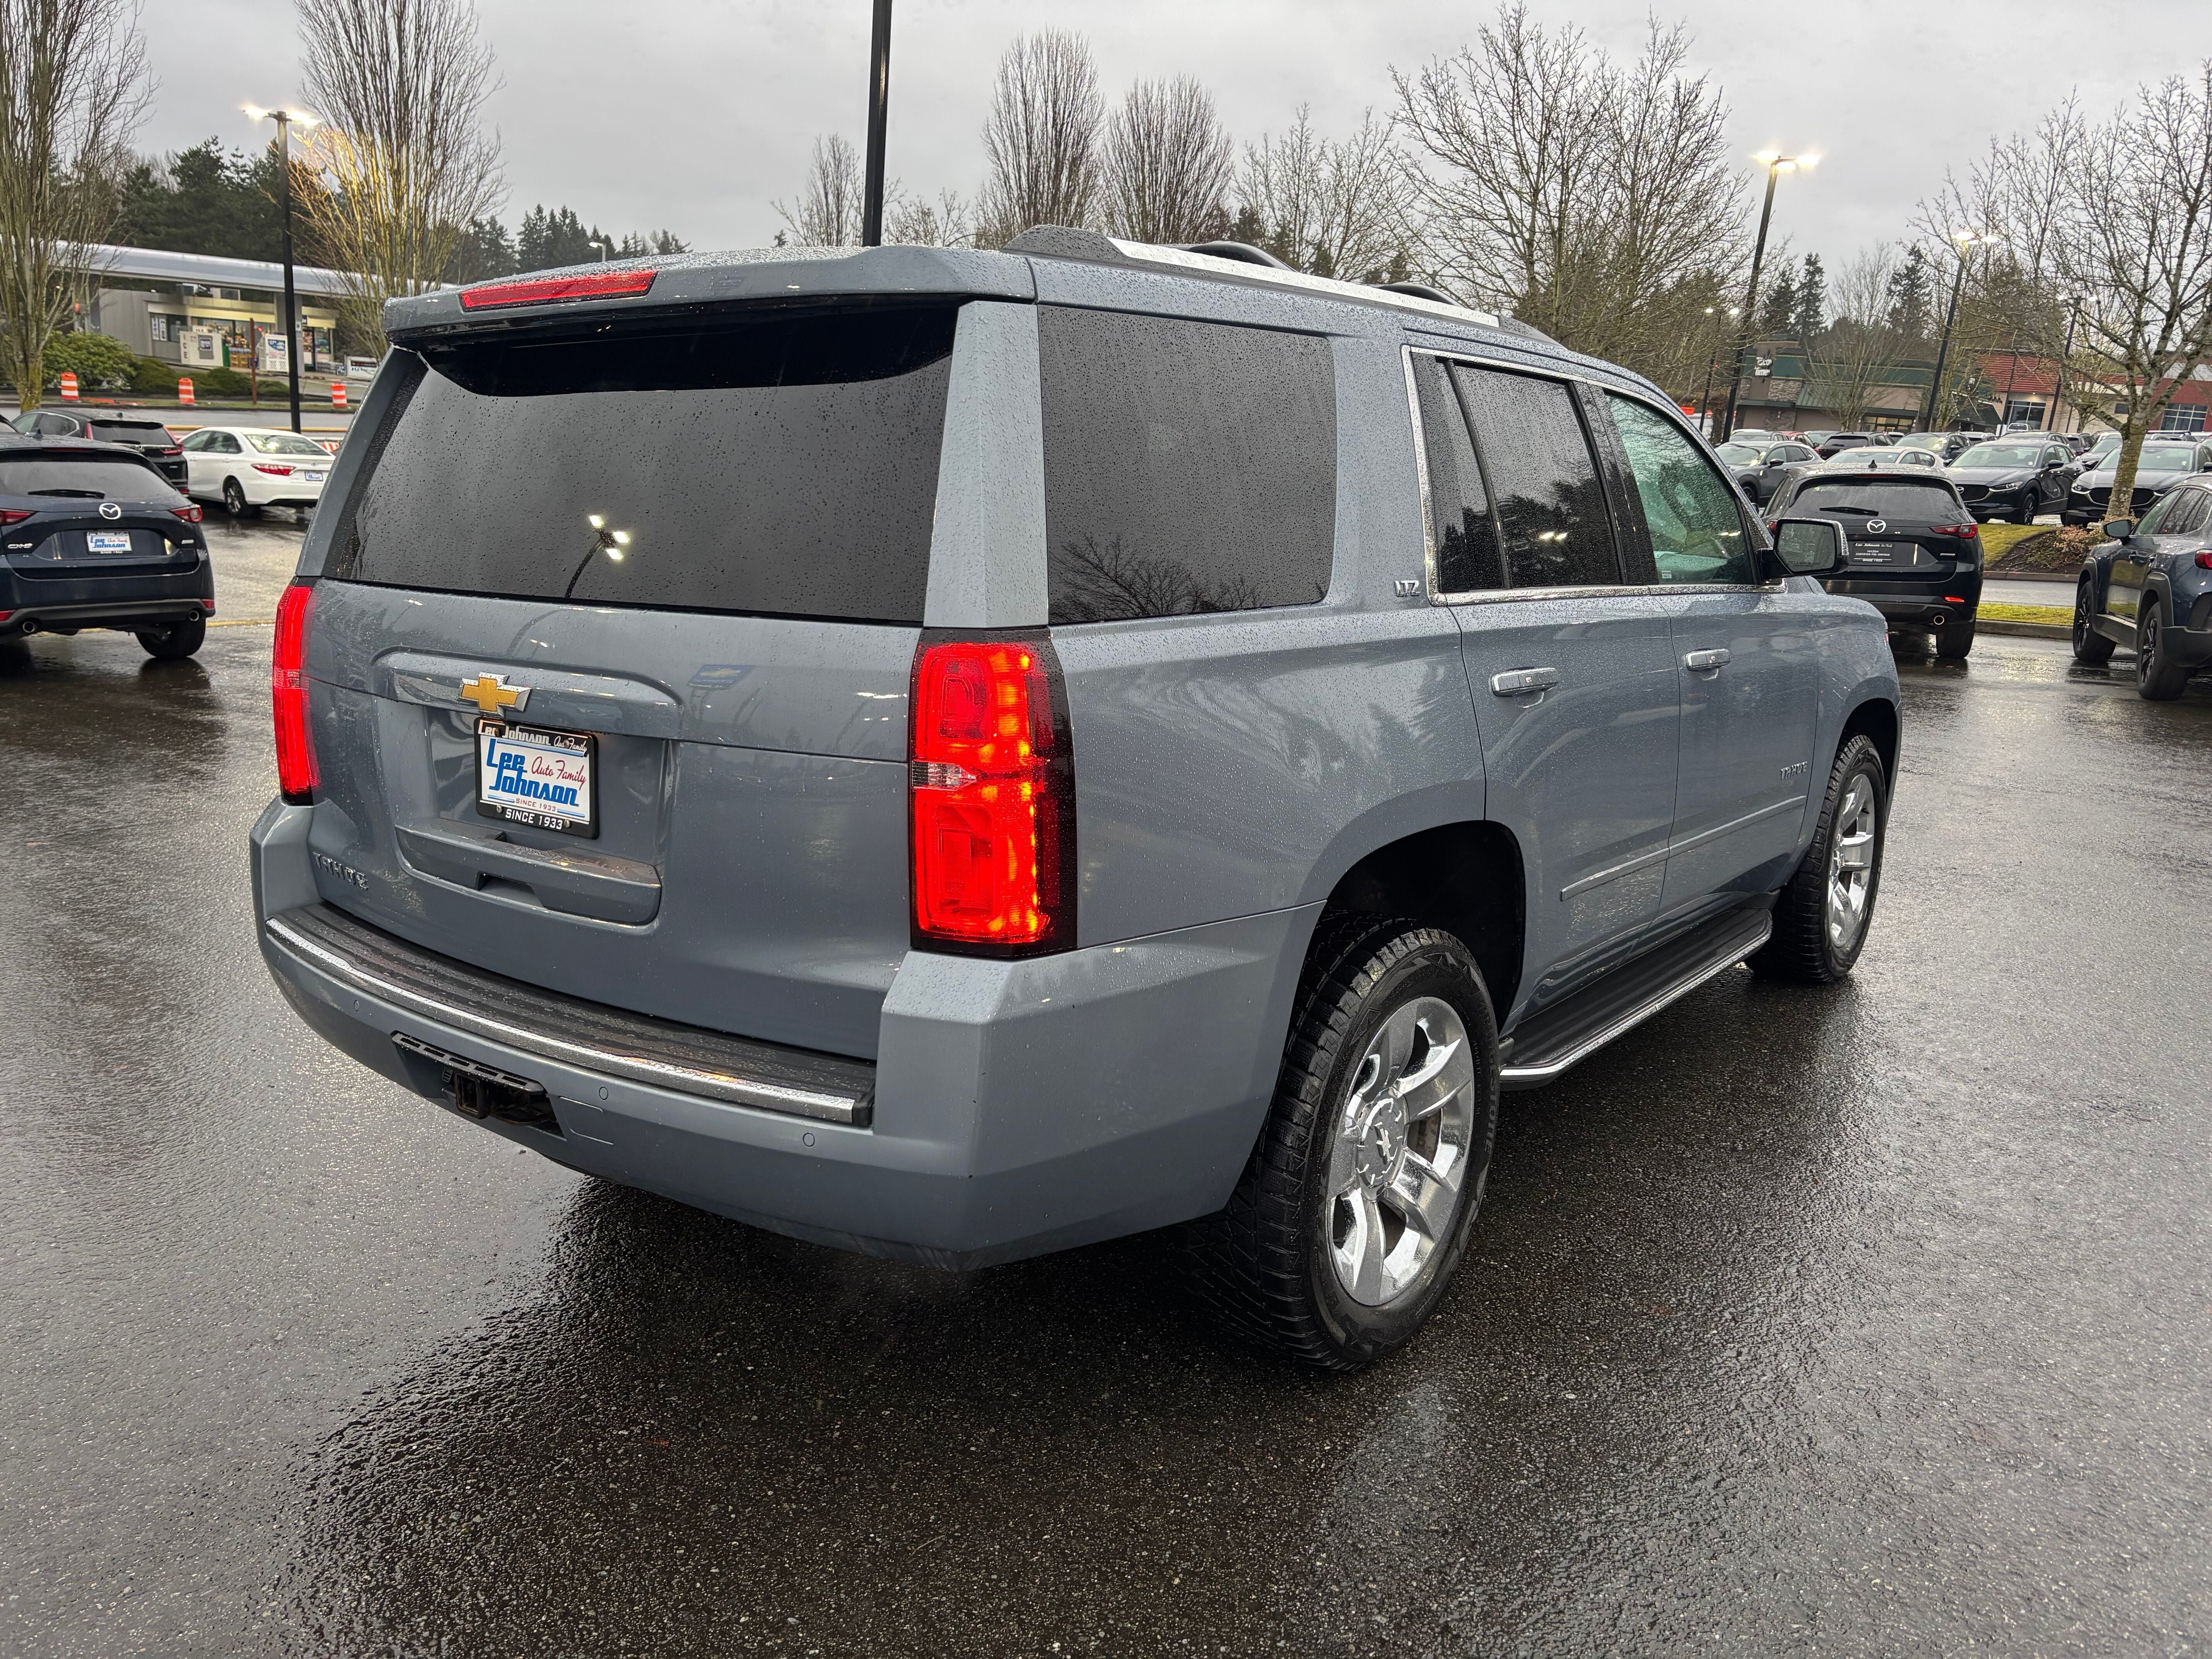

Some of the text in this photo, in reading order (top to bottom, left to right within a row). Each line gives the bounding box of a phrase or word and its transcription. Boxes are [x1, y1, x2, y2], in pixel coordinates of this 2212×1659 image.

[1756, 357, 1772, 366] Taco
[1394, 580, 1421, 597] LTZ
[486, 738, 526, 771] Lee
[502, 725, 551, 746] Johnson
[568, 737, 587, 757] Family
[489, 767, 579, 807] Johnson
[531, 756, 587, 791] Auto Family
[505, 809, 563, 830] SINCE 1933
[515, 798, 556, 812] SINCE 1933
[313, 852, 369, 890] TAHOE
